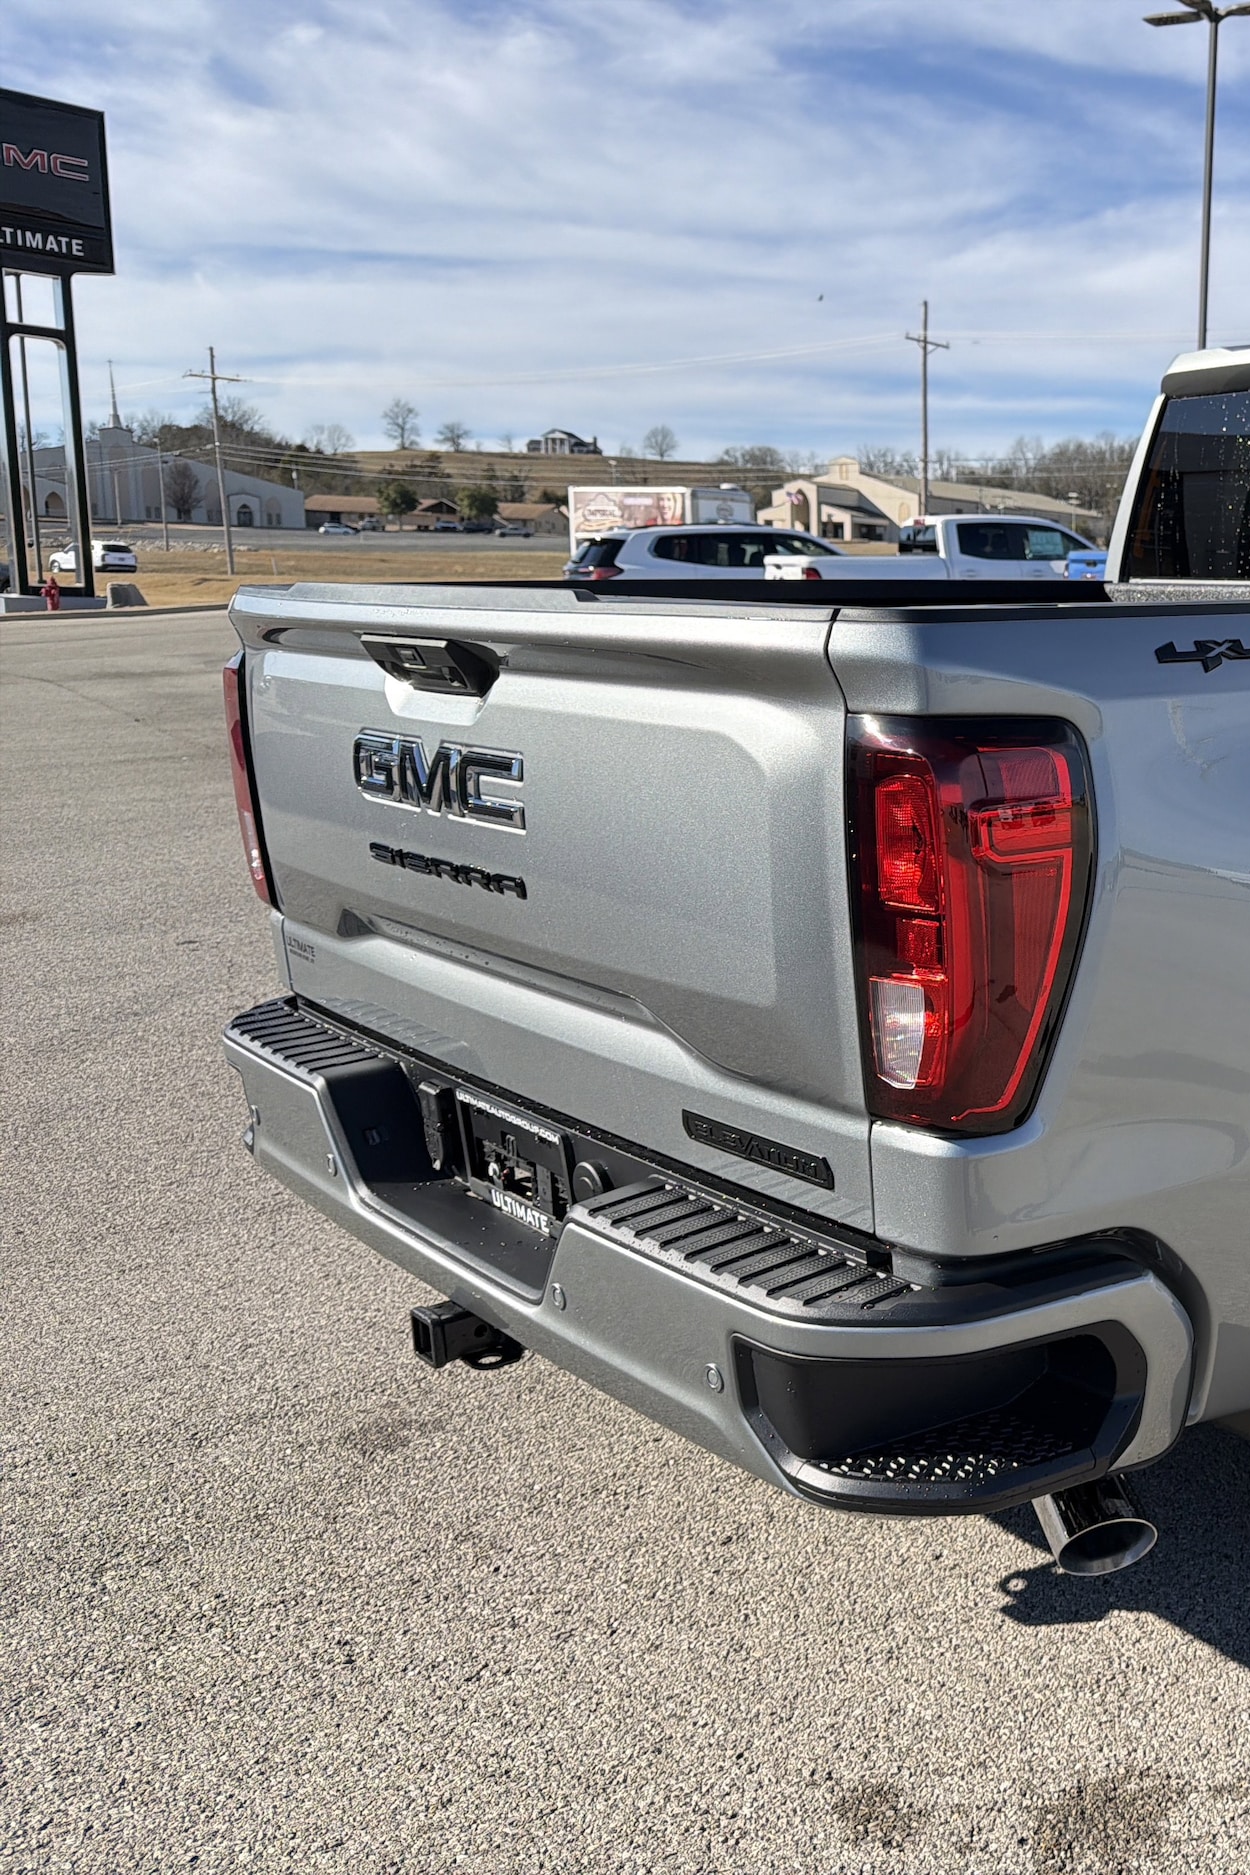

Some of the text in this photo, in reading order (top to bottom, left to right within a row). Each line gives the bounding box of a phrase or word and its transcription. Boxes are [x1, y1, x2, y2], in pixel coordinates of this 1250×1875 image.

[353, 728, 527, 835] GMC
[369, 841, 528, 900] SIERRA
[490, 1188, 550, 1234] ULTIMATE
